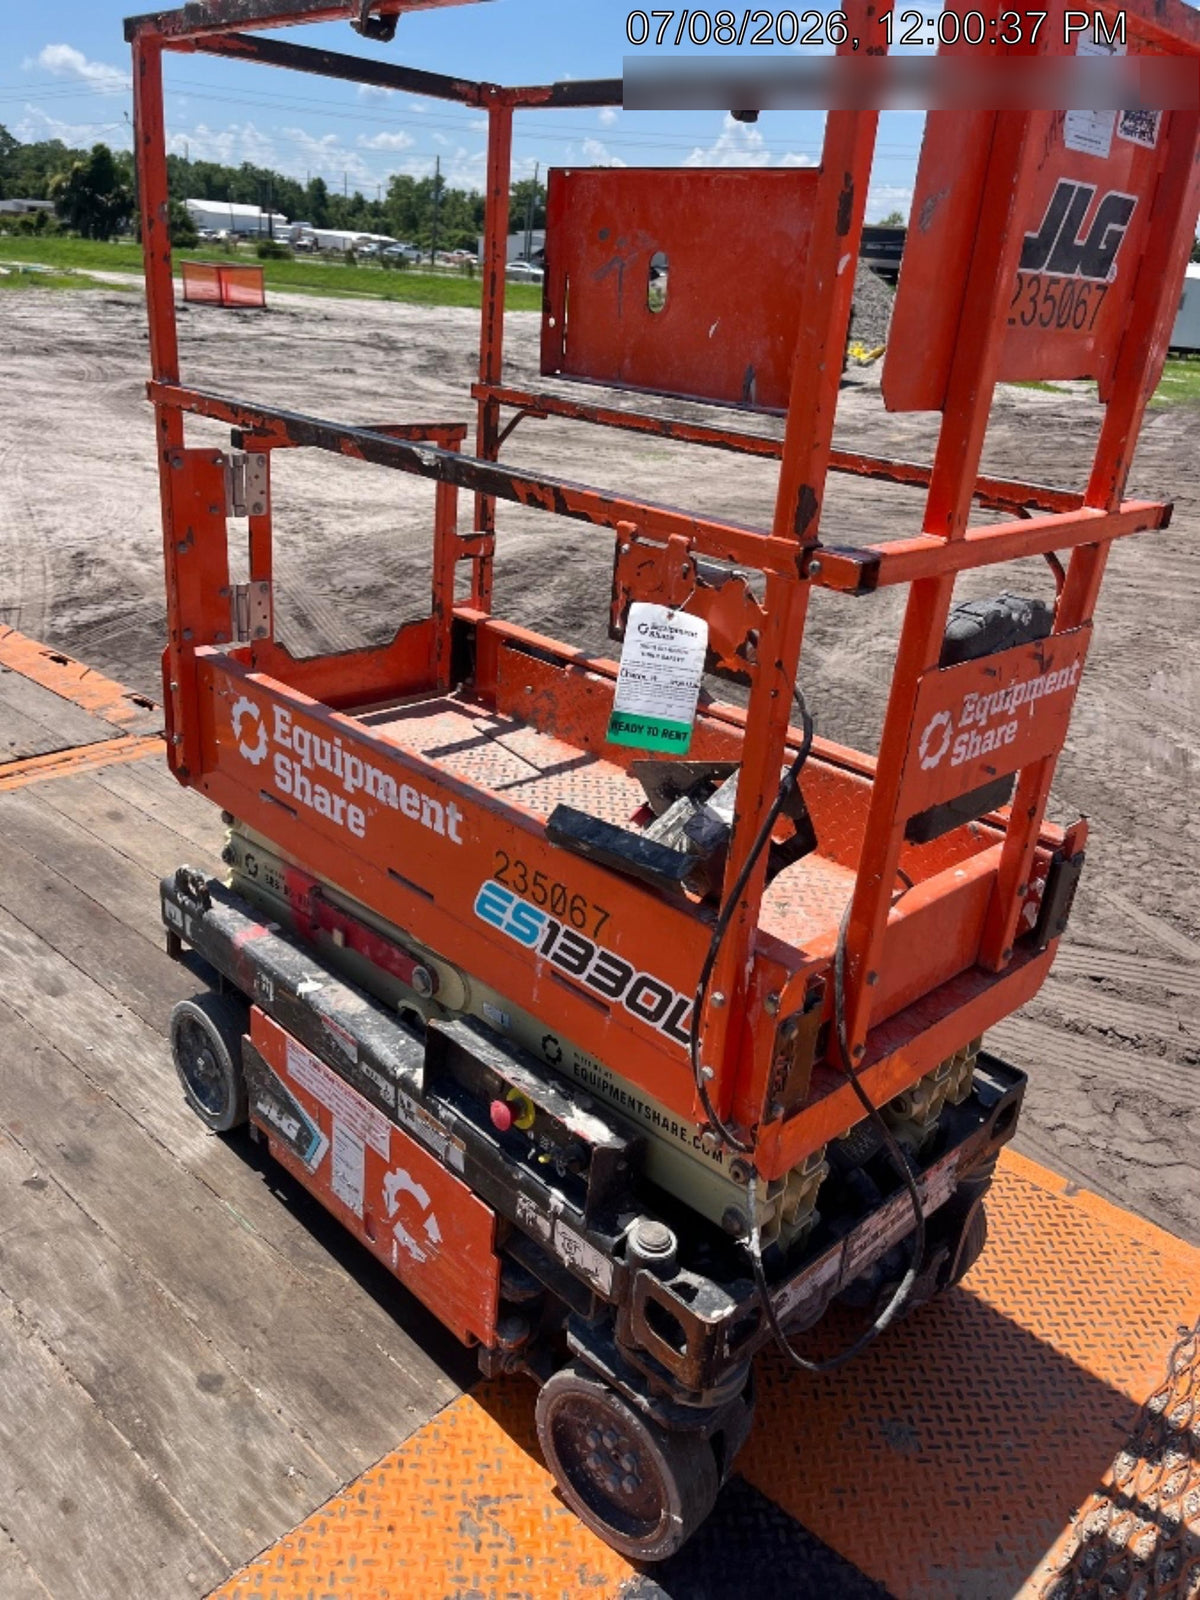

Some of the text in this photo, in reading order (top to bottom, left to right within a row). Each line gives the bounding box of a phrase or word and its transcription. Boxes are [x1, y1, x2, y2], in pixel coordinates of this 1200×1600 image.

[1018, 177, 1139, 281] JLG
[611, 721, 689, 742] READY TO RENT
[958, 660, 1080, 727] Equipment
[272, 703, 463, 845] Equipment
[951, 720, 1018, 767] Share
[273, 754, 366, 839] Share
[493, 850, 611, 938] 235067
[474, 880, 694, 1047] ES1330L
